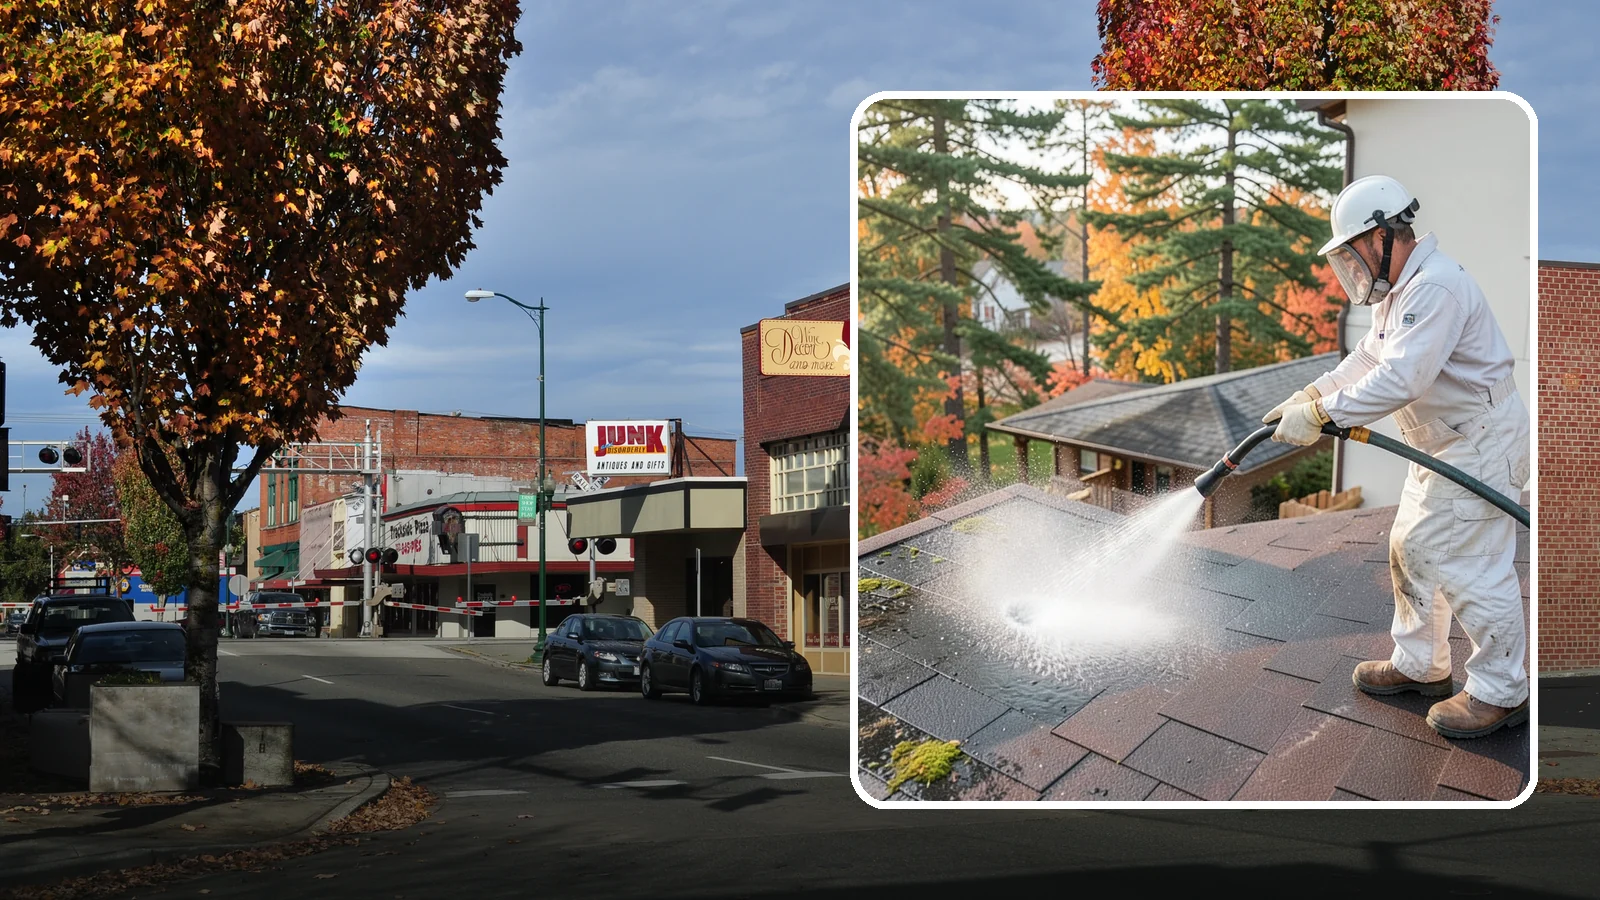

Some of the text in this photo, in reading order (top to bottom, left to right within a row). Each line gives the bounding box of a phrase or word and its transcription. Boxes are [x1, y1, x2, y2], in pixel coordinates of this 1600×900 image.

[595, 425, 664, 457] JUNK
[607, 446, 646, 454] DISORDERLY
[597, 460, 665, 470] ANTIQUES AND GIFTS
